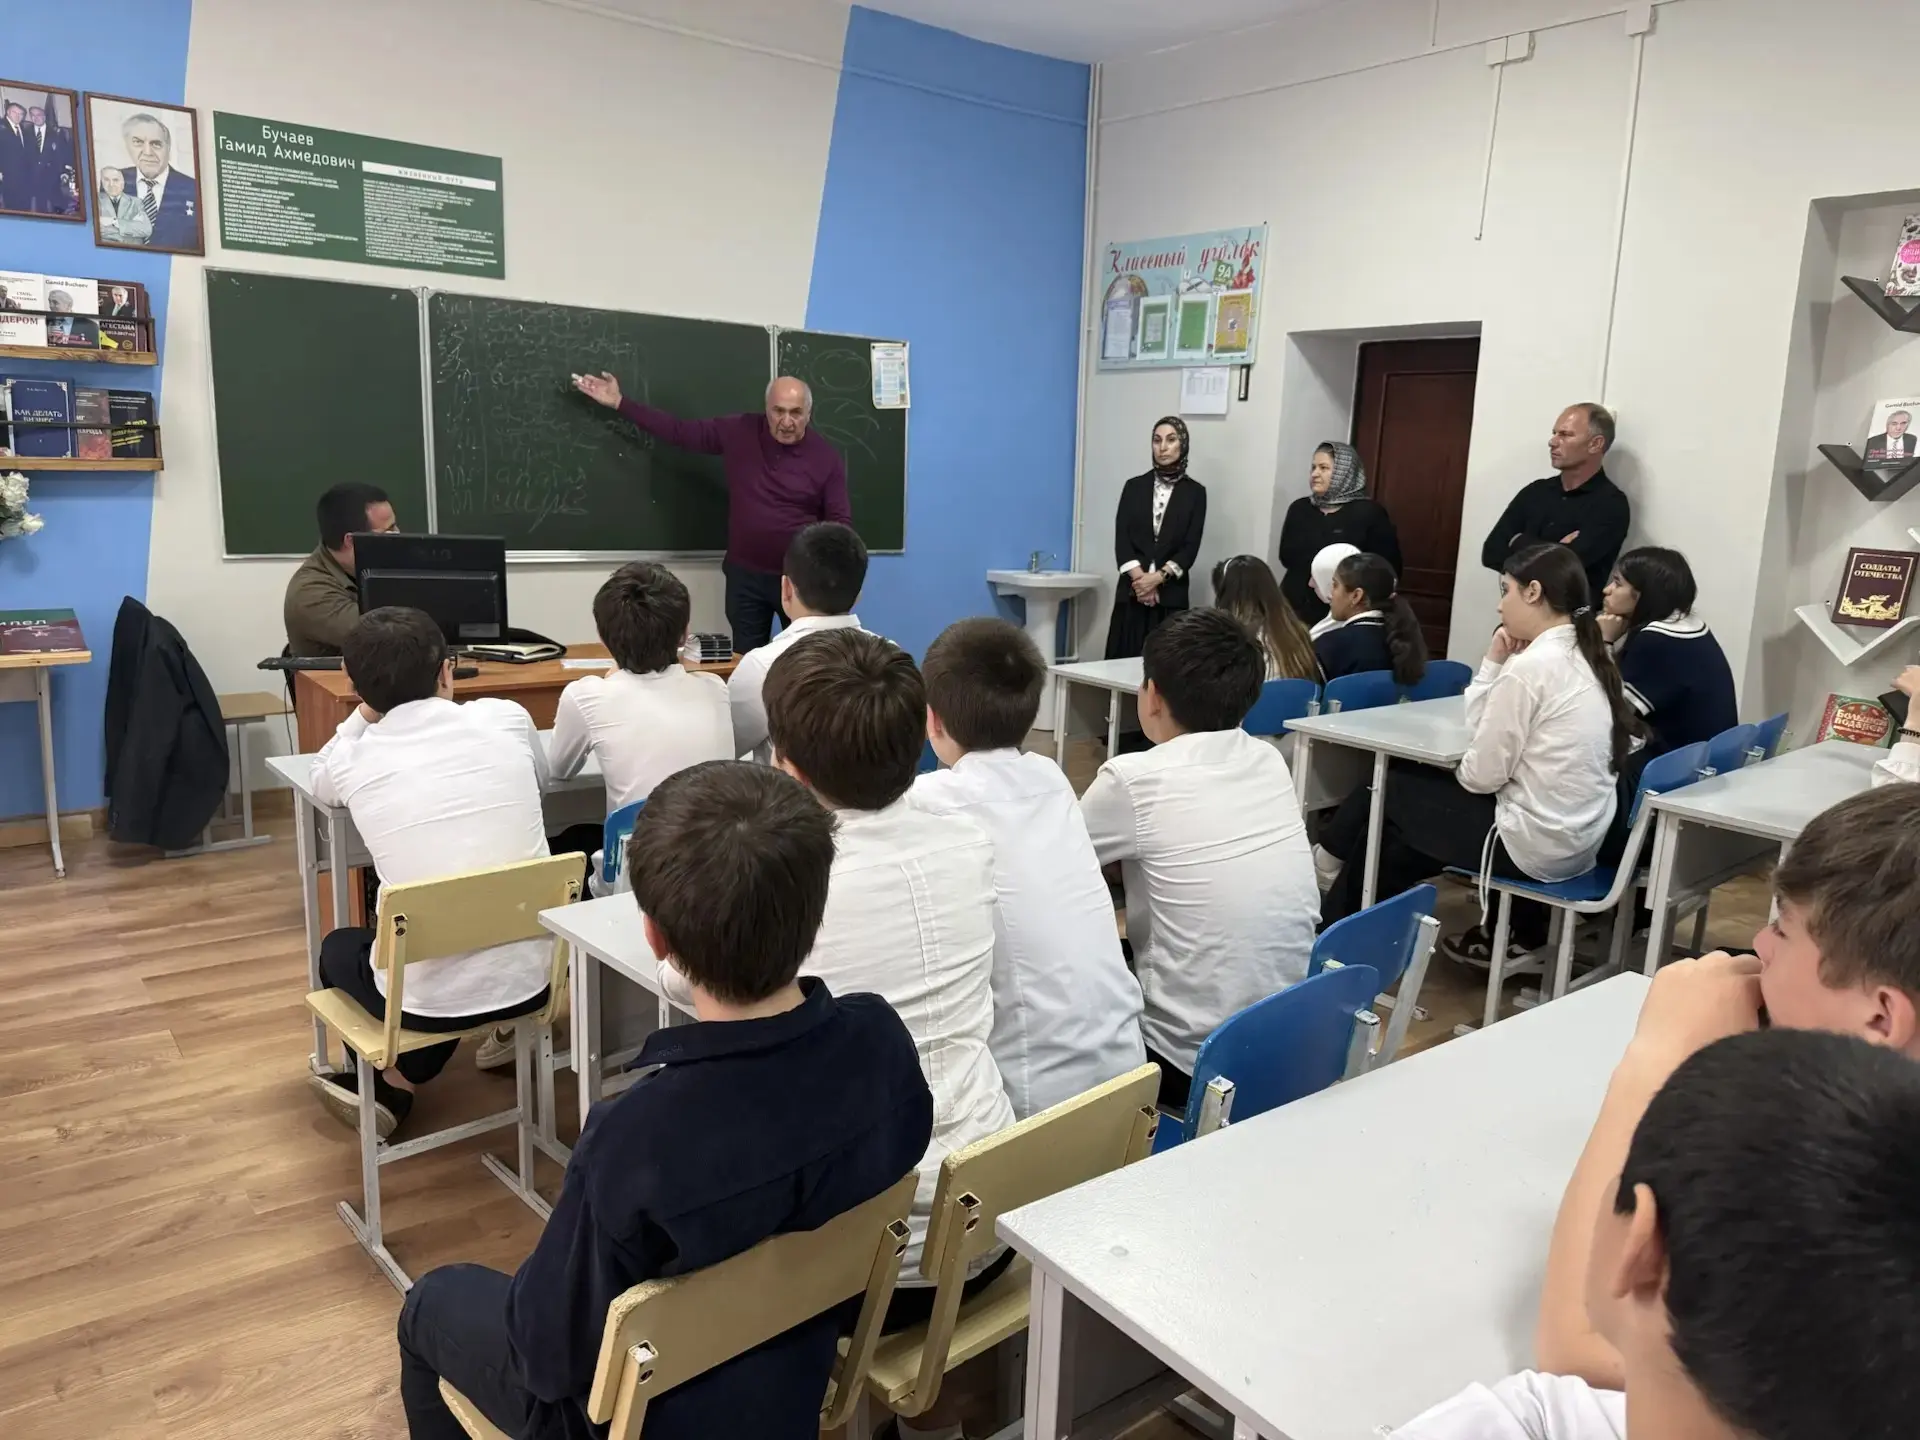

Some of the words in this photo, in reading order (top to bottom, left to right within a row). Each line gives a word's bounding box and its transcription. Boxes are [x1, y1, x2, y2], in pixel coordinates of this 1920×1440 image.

[262, 125, 314, 146] Бучаев
[219, 135, 267, 158] Гамид
[274, 144, 356, 169] Ахмедович
[1108, 246, 1186, 274] Классный
[100, 322, 135, 331] АГЕСТАНА
[32, 409, 62, 417] ДЕЛАТЬ
[1860, 563, 1901, 572] СОЛДАТЫ
[1854, 570, 1902, 580] ОТЕЧЕСТВА
[1836, 709, 1888, 727] Большой
